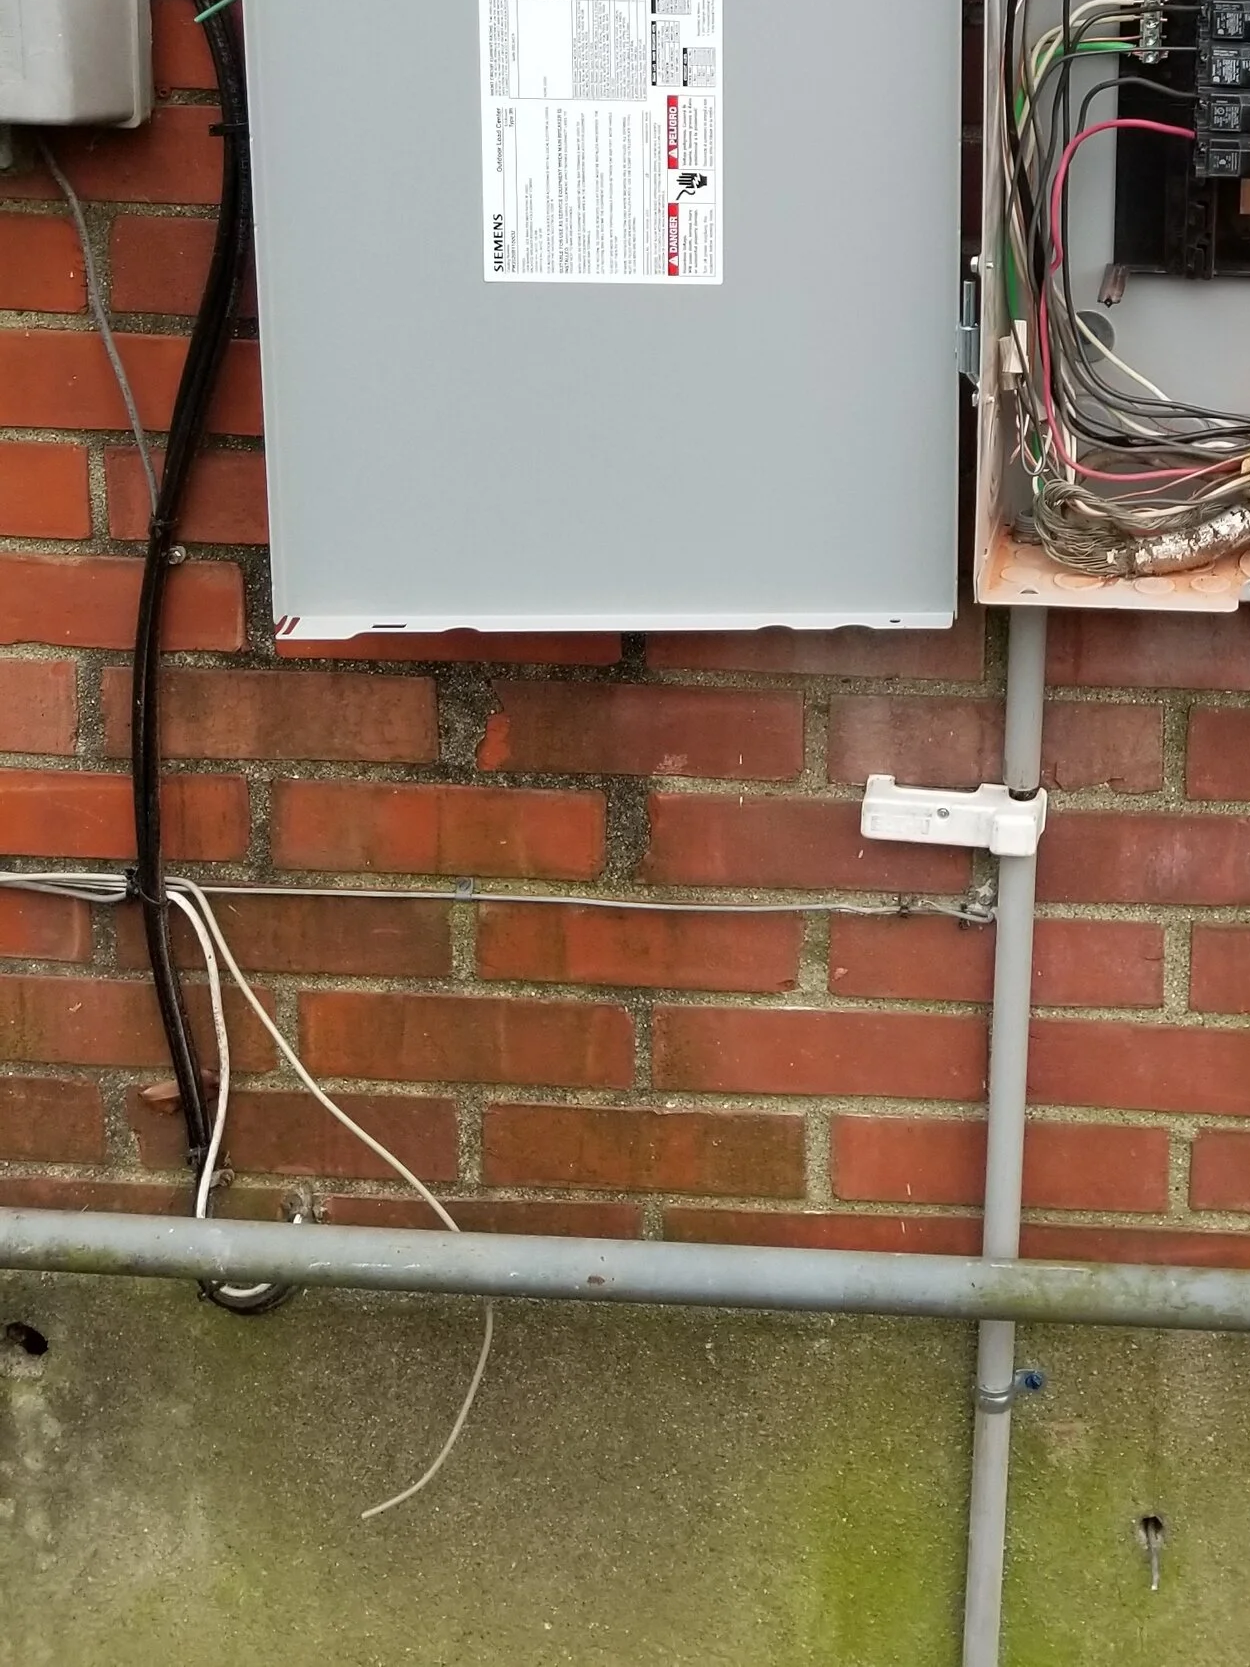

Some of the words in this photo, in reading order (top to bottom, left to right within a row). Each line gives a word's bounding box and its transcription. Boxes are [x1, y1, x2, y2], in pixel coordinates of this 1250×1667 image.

[669, 106, 677, 145] PELIGRO
[493, 214, 503, 272] SIEMENS
[670, 216, 678, 253] DANGER
